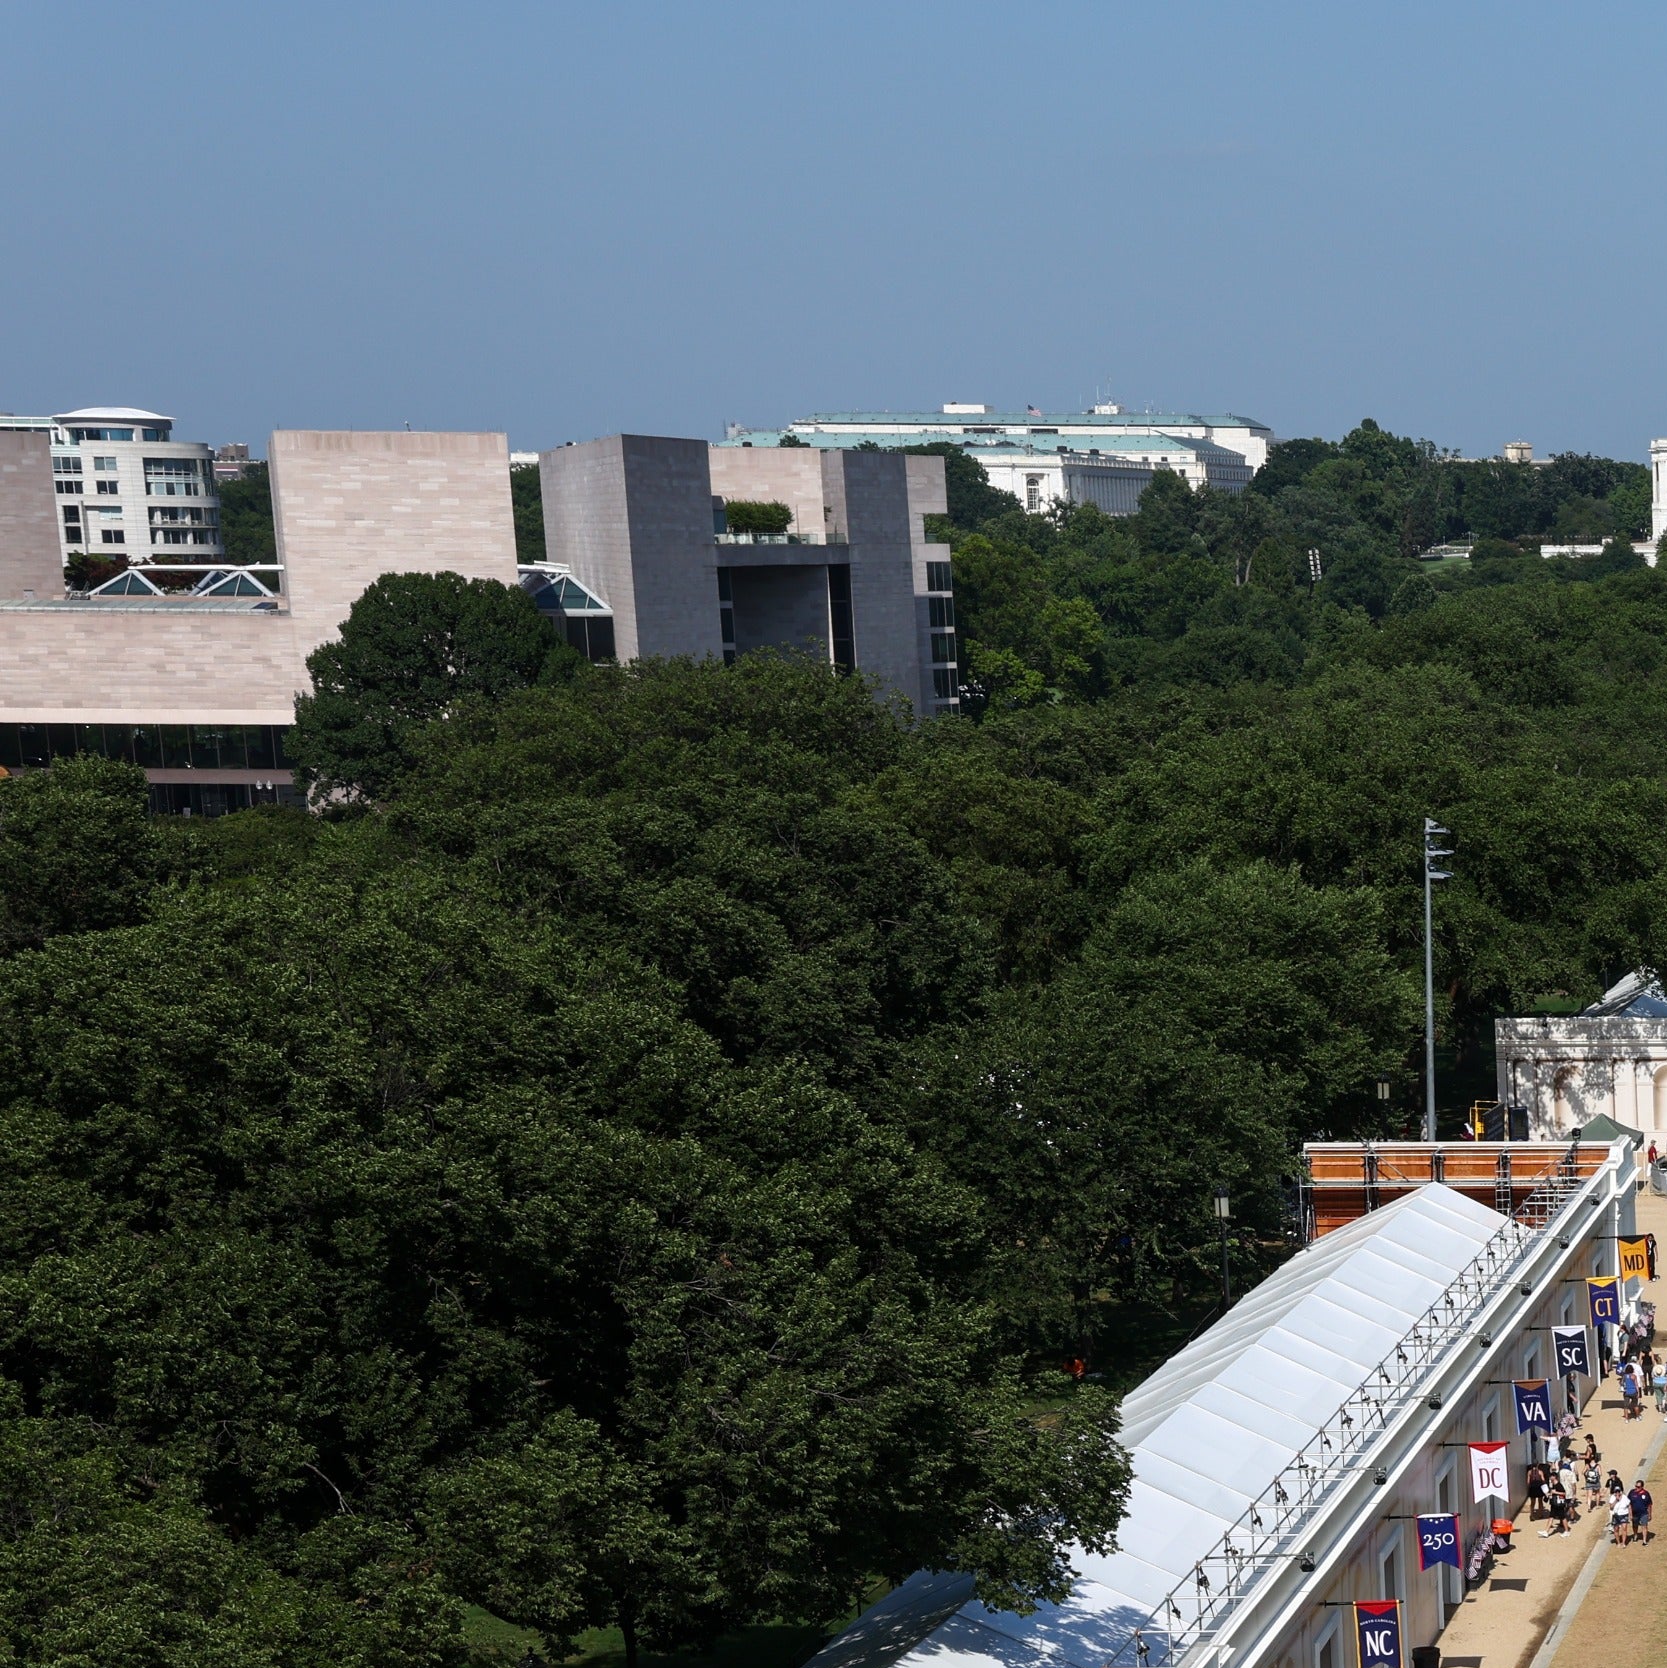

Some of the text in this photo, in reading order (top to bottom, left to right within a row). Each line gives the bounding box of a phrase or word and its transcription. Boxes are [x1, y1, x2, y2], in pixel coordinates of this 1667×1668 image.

[1624, 1254, 1645, 1271] MD
[1594, 1298, 1613, 1317] CT
[1562, 1347, 1582, 1366] SC
[1521, 1402, 1546, 1422] VA
[1479, 1468, 1503, 1489] DC
[1423, 1533, 1455, 1550] 250
[1365, 1630, 1394, 1657] NC
